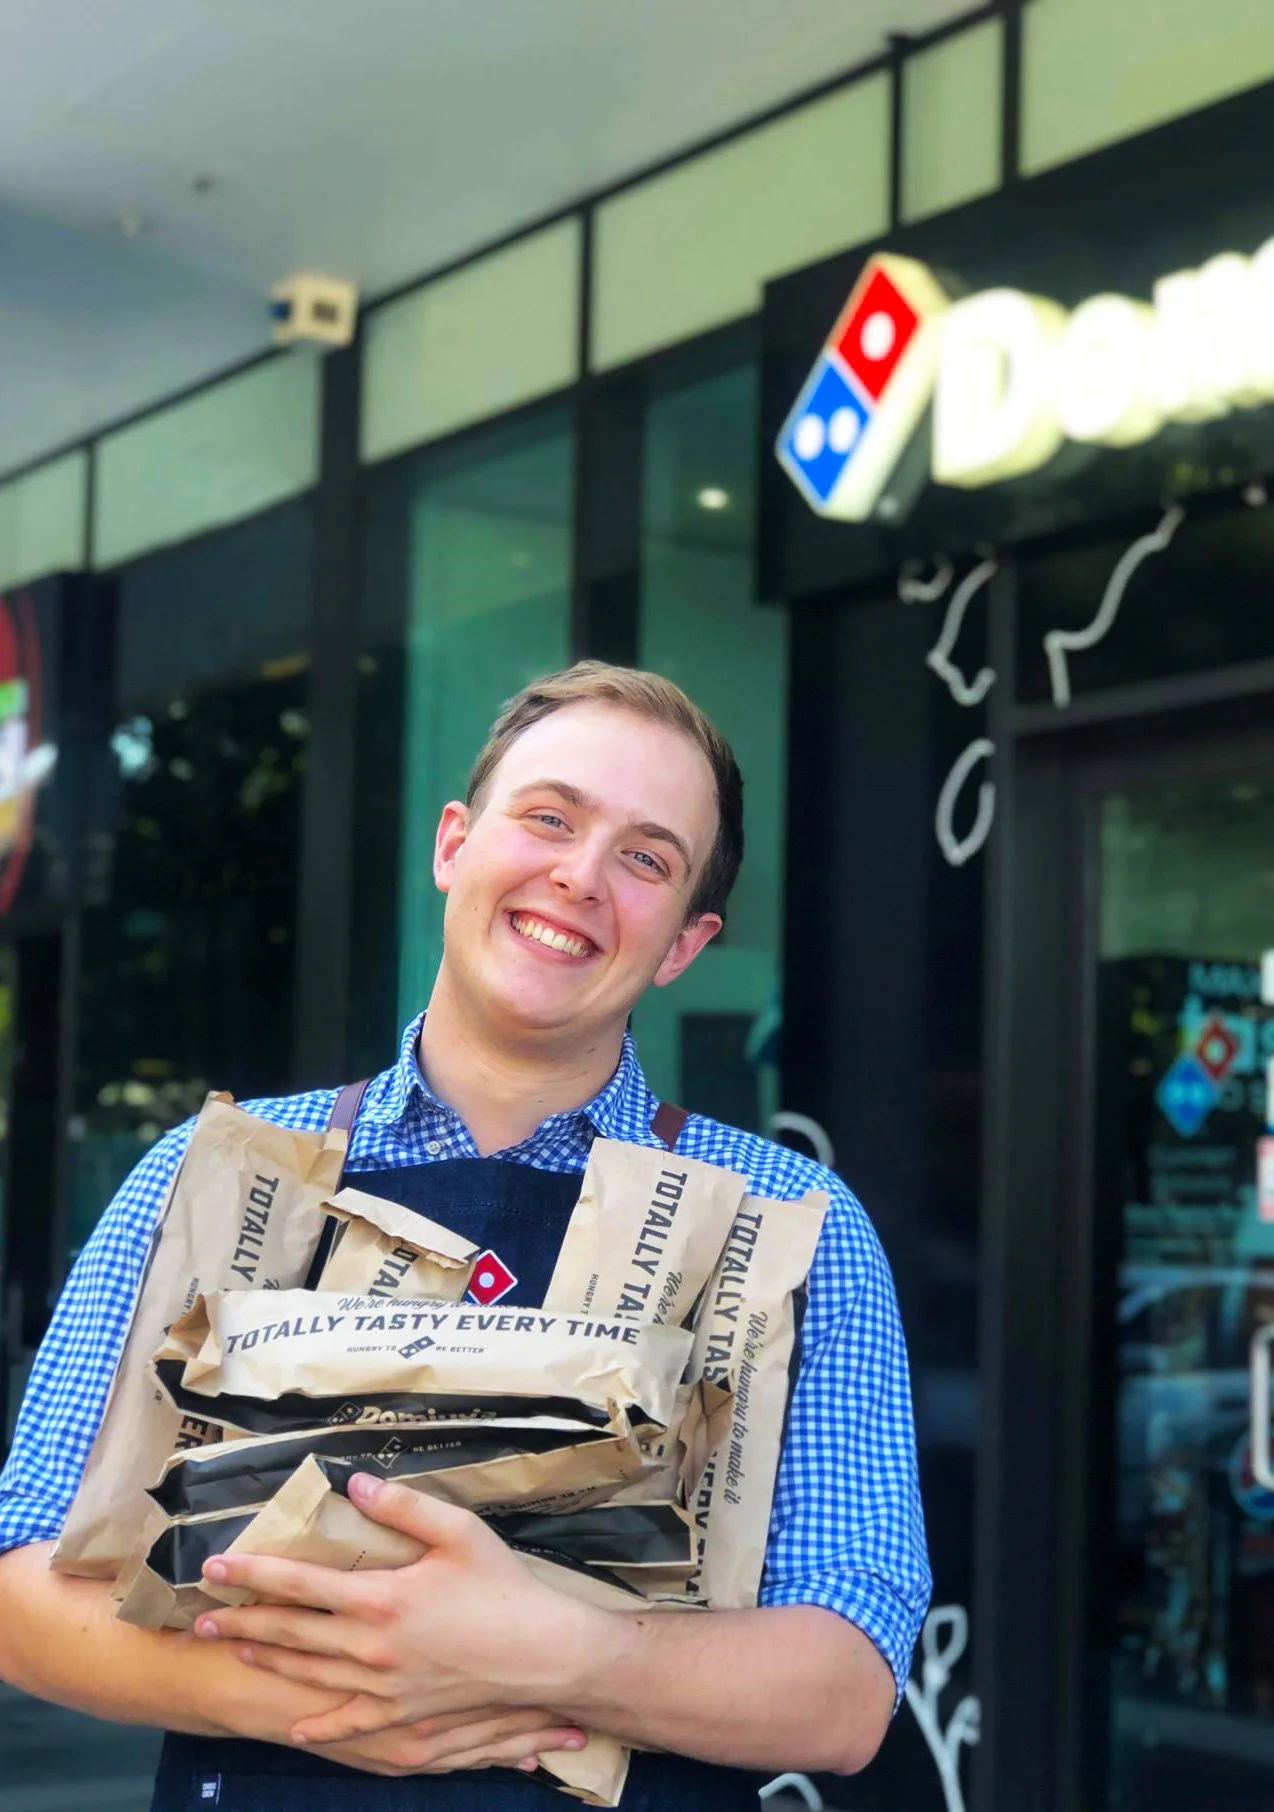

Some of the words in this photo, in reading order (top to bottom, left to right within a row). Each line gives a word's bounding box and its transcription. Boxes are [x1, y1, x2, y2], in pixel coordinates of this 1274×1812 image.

[230, 1173, 280, 1283] TOTALLY
[632, 1170, 688, 1276] TOTALLY
[583, 1273, 599, 1308] HUNGRY
[713, 1213, 763, 1322] TOTALLY
[226, 1315, 346, 1354] TOTALLY
[354, 1313, 449, 1331] TASTY
[455, 1314, 557, 1333] EVERY
[566, 1319, 641, 1345] TIME
[346, 1345, 384, 1353] HUNGRY
[450, 1346, 485, 1354] BETTER
[744, 1311, 769, 1359] We're
[734, 1359, 758, 1421] hungry
[732, 1421, 749, 1441] to
[726, 1440, 745, 1488] make
[723, 1488, 742, 1505] it
